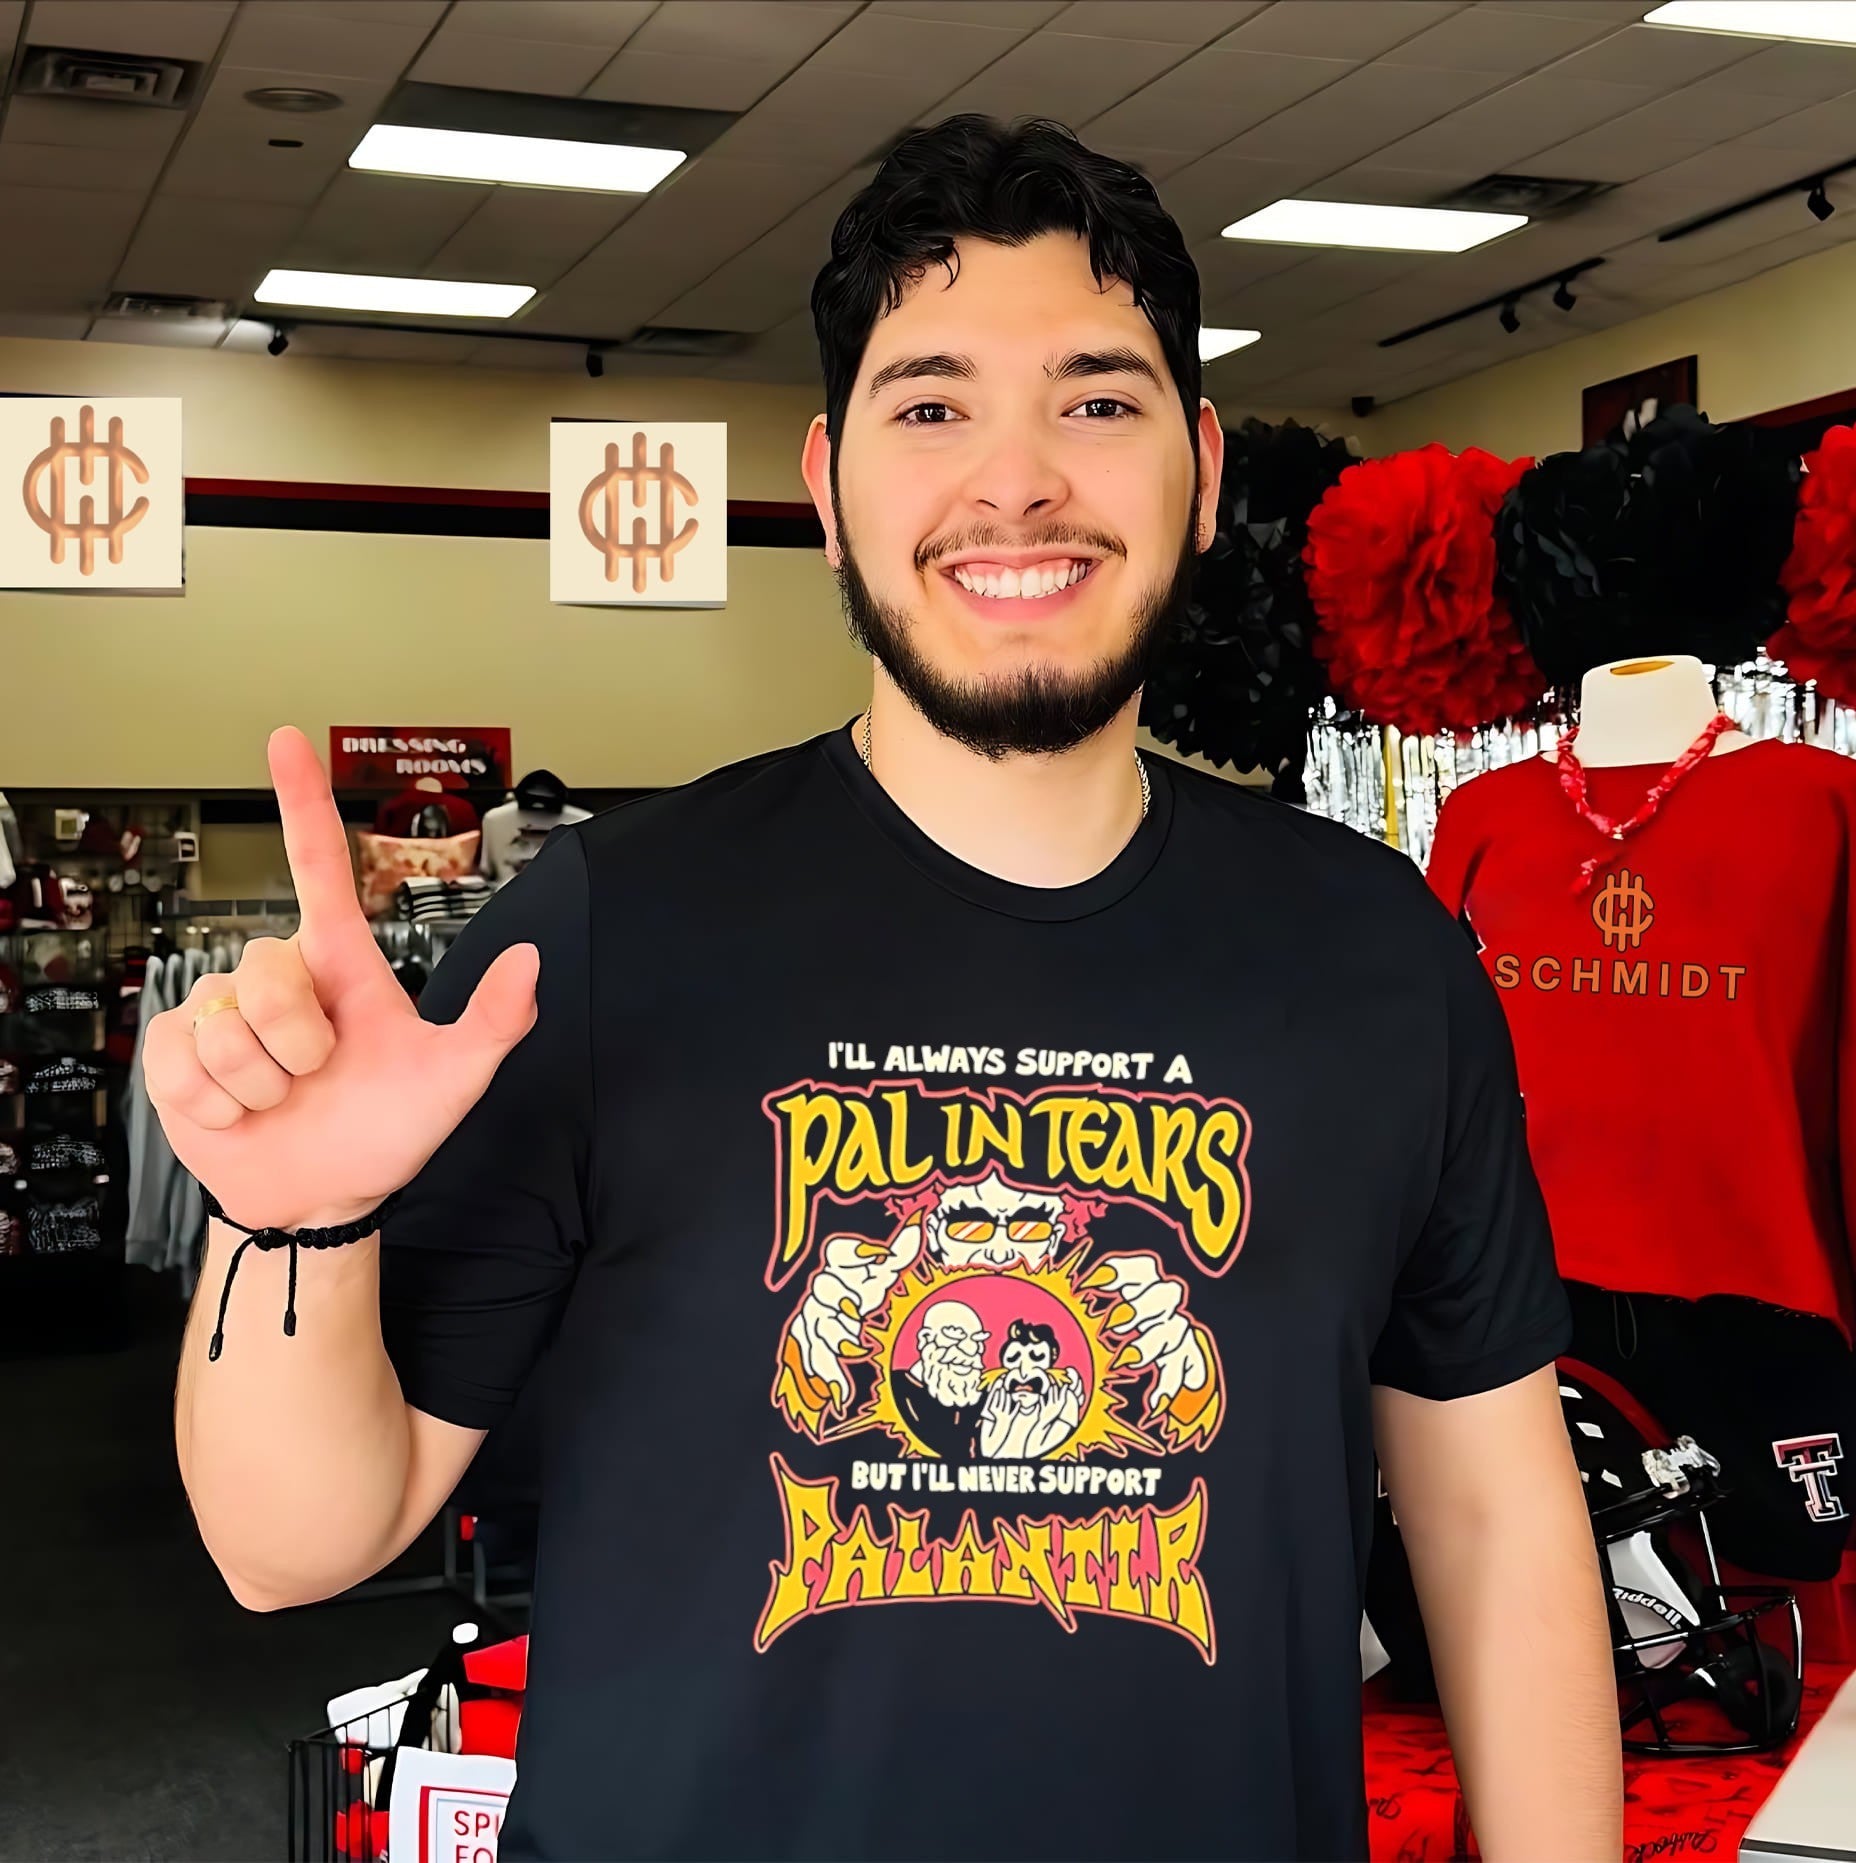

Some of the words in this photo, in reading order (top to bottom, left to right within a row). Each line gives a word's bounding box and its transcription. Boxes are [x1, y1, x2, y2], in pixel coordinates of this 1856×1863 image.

[1494, 953, 1747, 1001] SCHMIDT
[829, 1042, 875, 1071] I'LL
[883, 1045, 1006, 1075] ALWAYS
[1015, 1048, 1154, 1080] SUPPORT
[1163, 1054, 1193, 1084] A
[775, 1089, 935, 1263] PAL
[940, 1102, 1024, 1169] IN
[1029, 1096, 1240, 1258] TEARS
[851, 1460, 906, 1491] BUT
[911, 1462, 955, 1492] I'LL
[958, 1464, 1036, 1494] NEVER
[1038, 1464, 1162, 1497] SUPPORT
[756, 1460, 1213, 1658] PALANTIR
